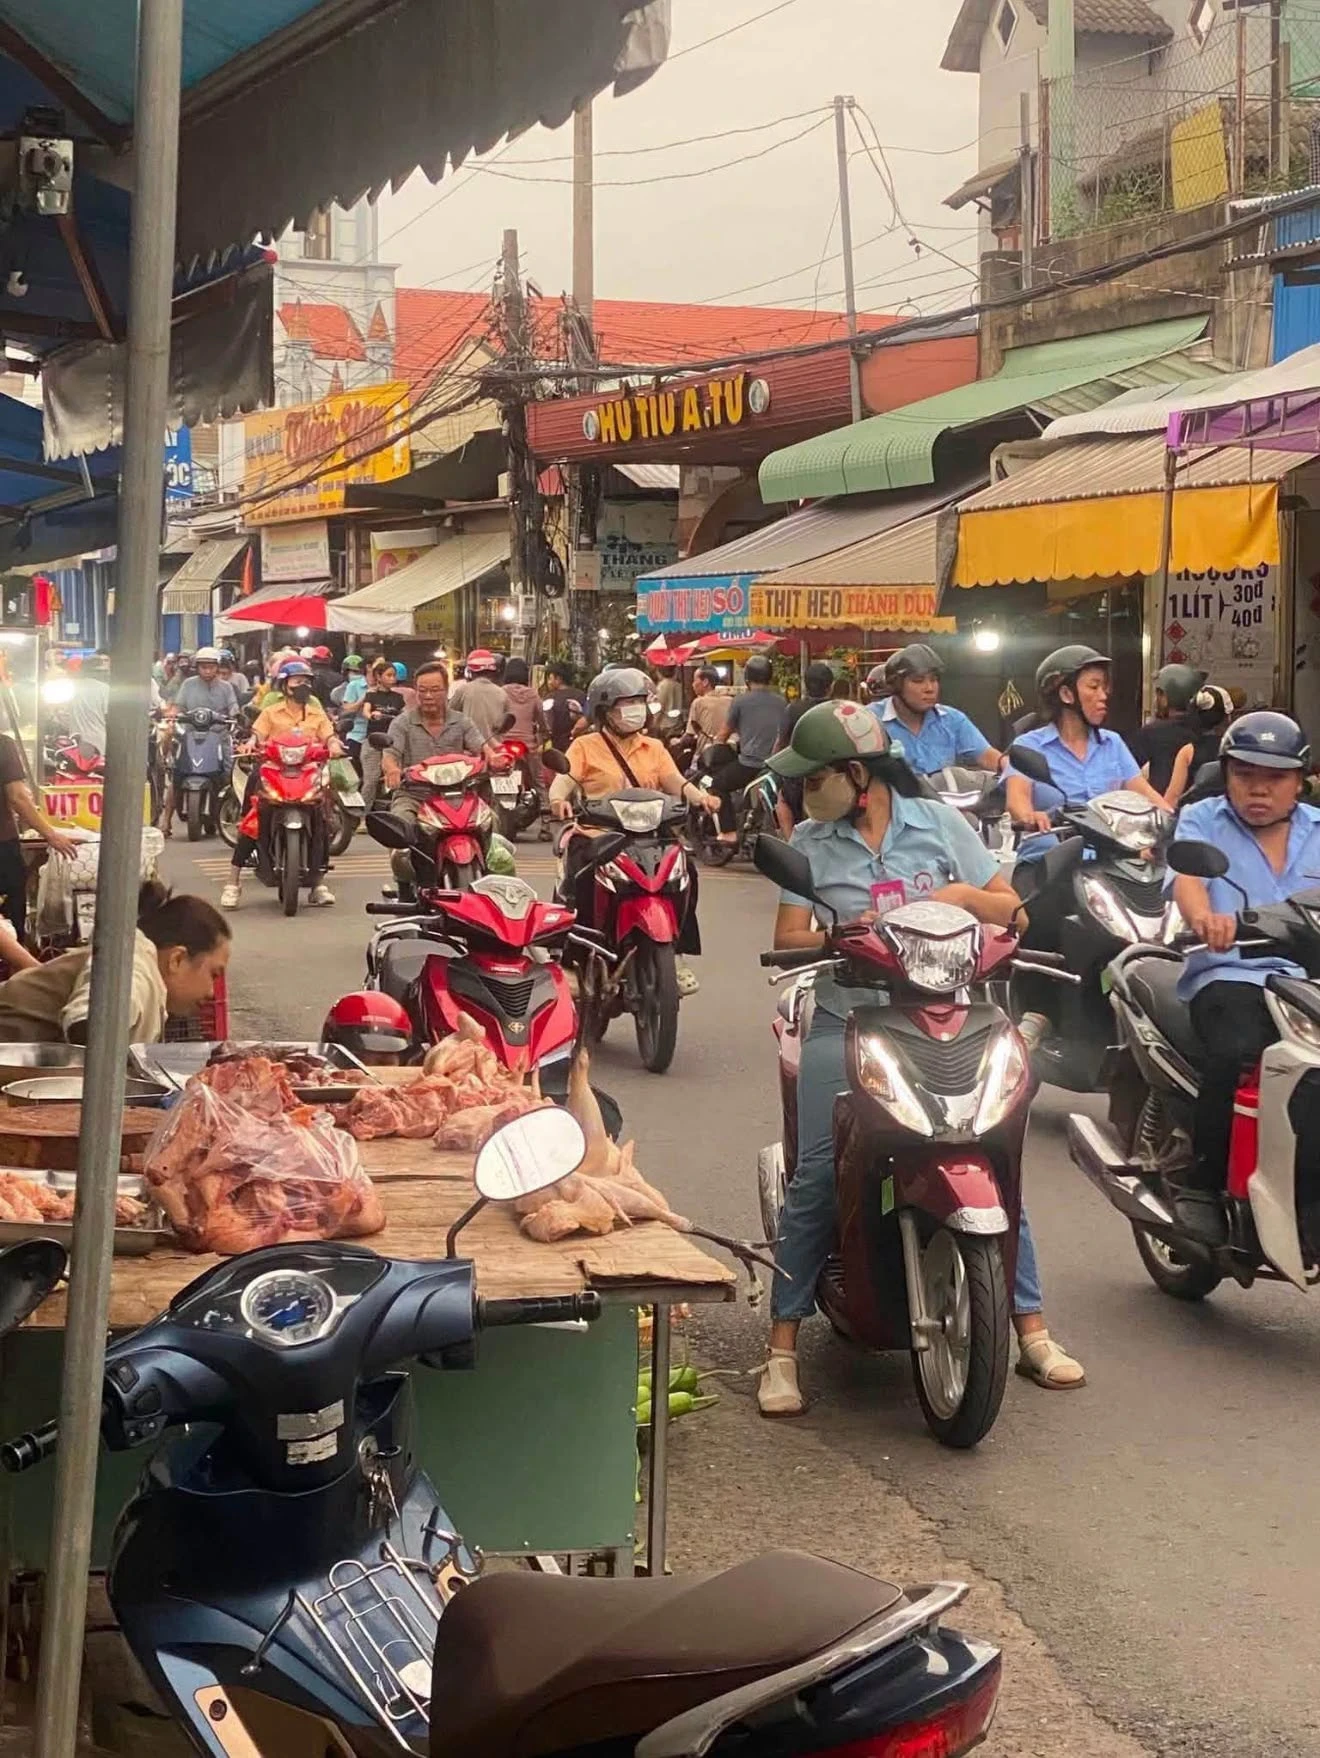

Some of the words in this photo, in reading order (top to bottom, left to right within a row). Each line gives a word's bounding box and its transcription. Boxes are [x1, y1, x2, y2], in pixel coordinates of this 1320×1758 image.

[765, 589, 801, 622] THỊT
[808, 590, 842, 617] HEO
[44, 793, 80, 820] VỊT
